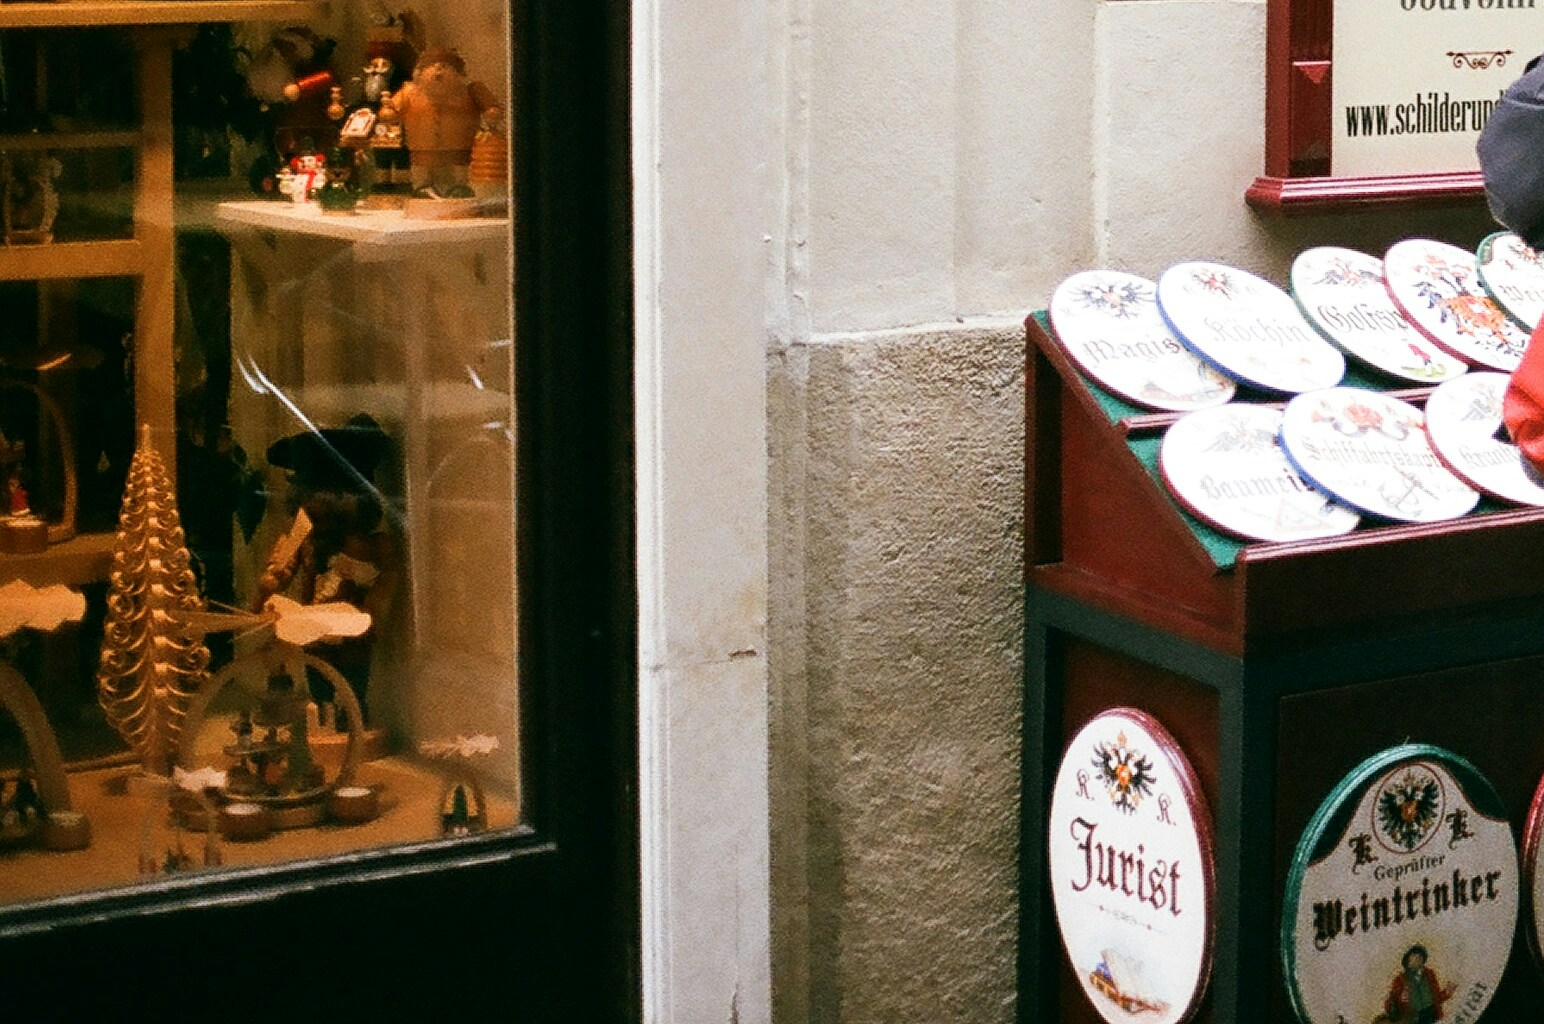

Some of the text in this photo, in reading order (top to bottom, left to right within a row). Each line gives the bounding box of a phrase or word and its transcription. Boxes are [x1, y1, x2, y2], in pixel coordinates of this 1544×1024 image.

[1069, 816, 1184, 917] Jurist
[1373, 853, 1447, 882] Geprüfter
[1312, 869, 1503, 952] Weintrinker
